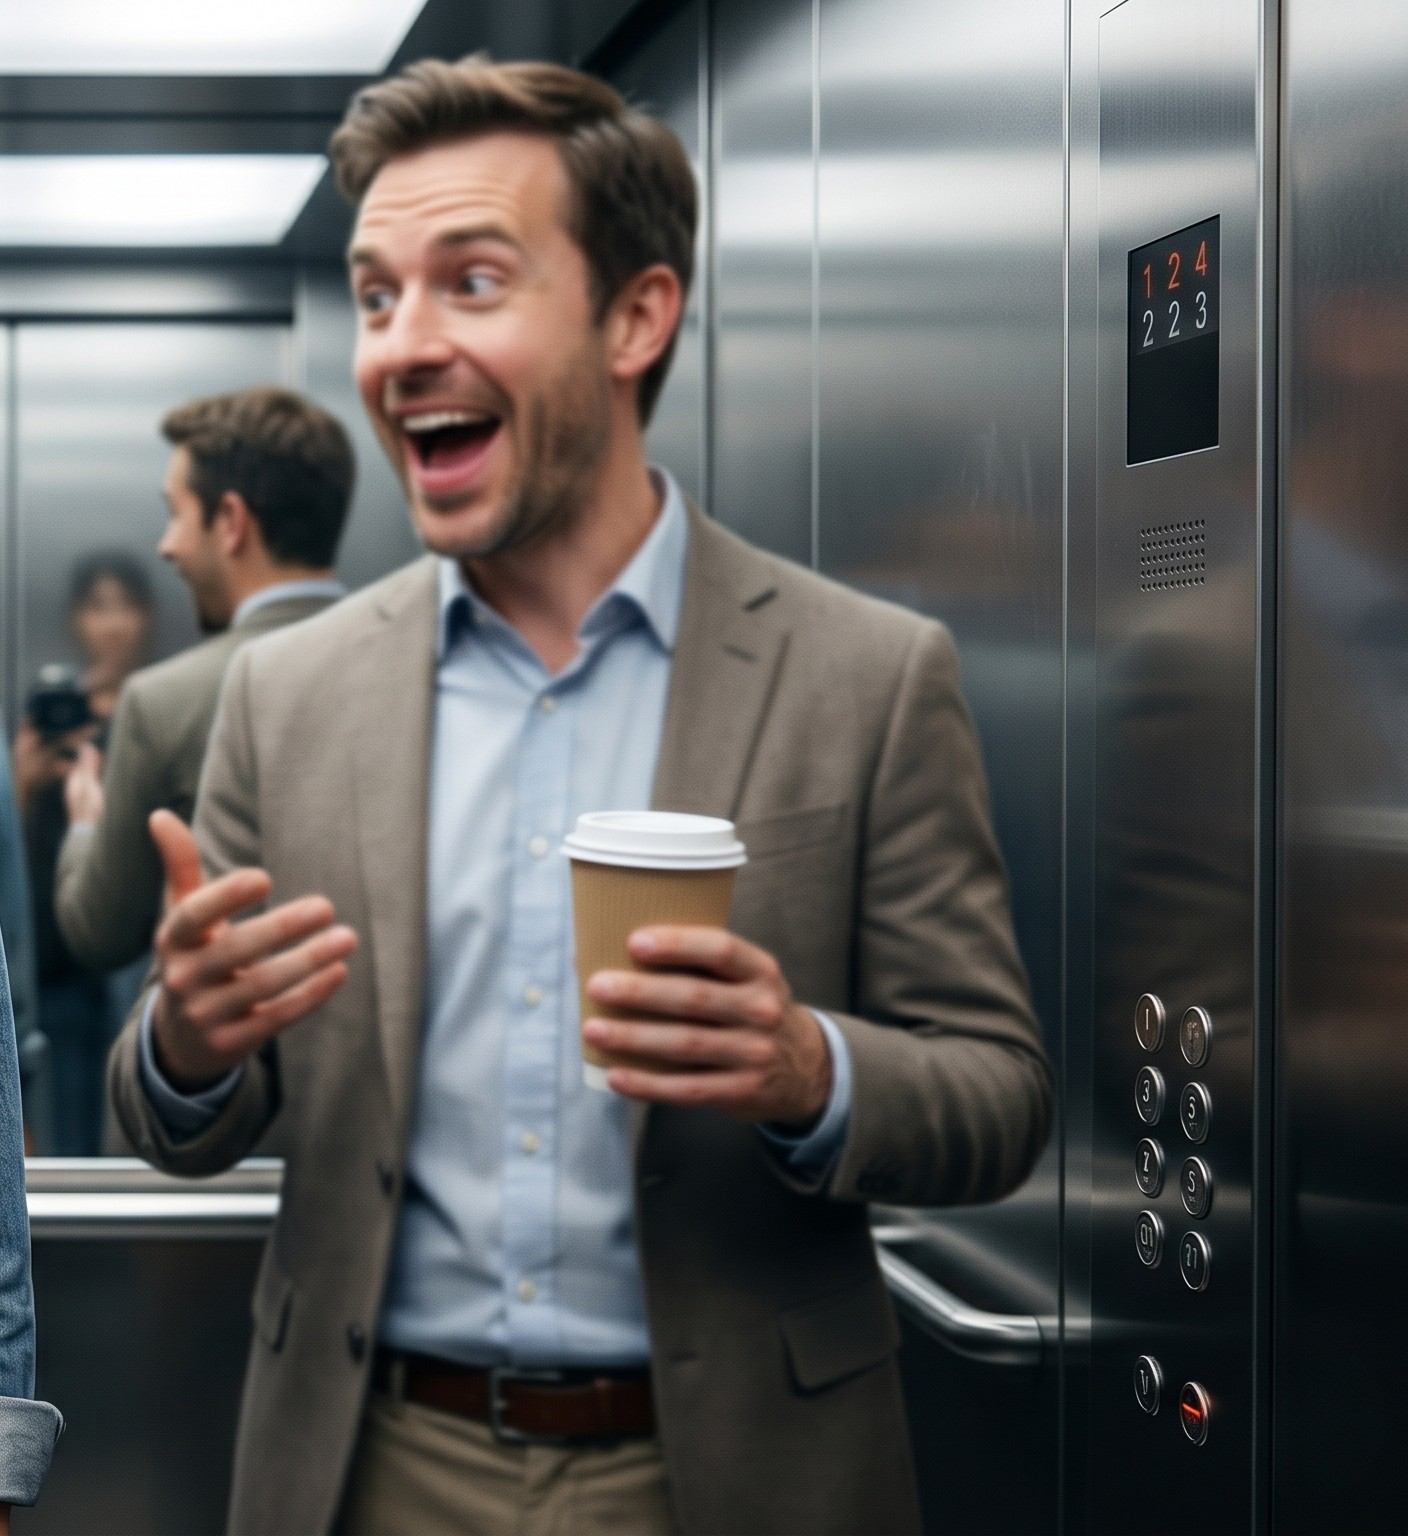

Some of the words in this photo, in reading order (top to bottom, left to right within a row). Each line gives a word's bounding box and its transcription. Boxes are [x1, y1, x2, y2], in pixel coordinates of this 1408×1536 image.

[1143, 263, 1152, 299] 1
[1167, 251, 1181, 290] 2
[1195, 239, 1208, 277] 4
[1142, 309, 1154, 348] 2
[1168, 300, 1180, 339] 2
[1195, 290, 1208, 329] 3
